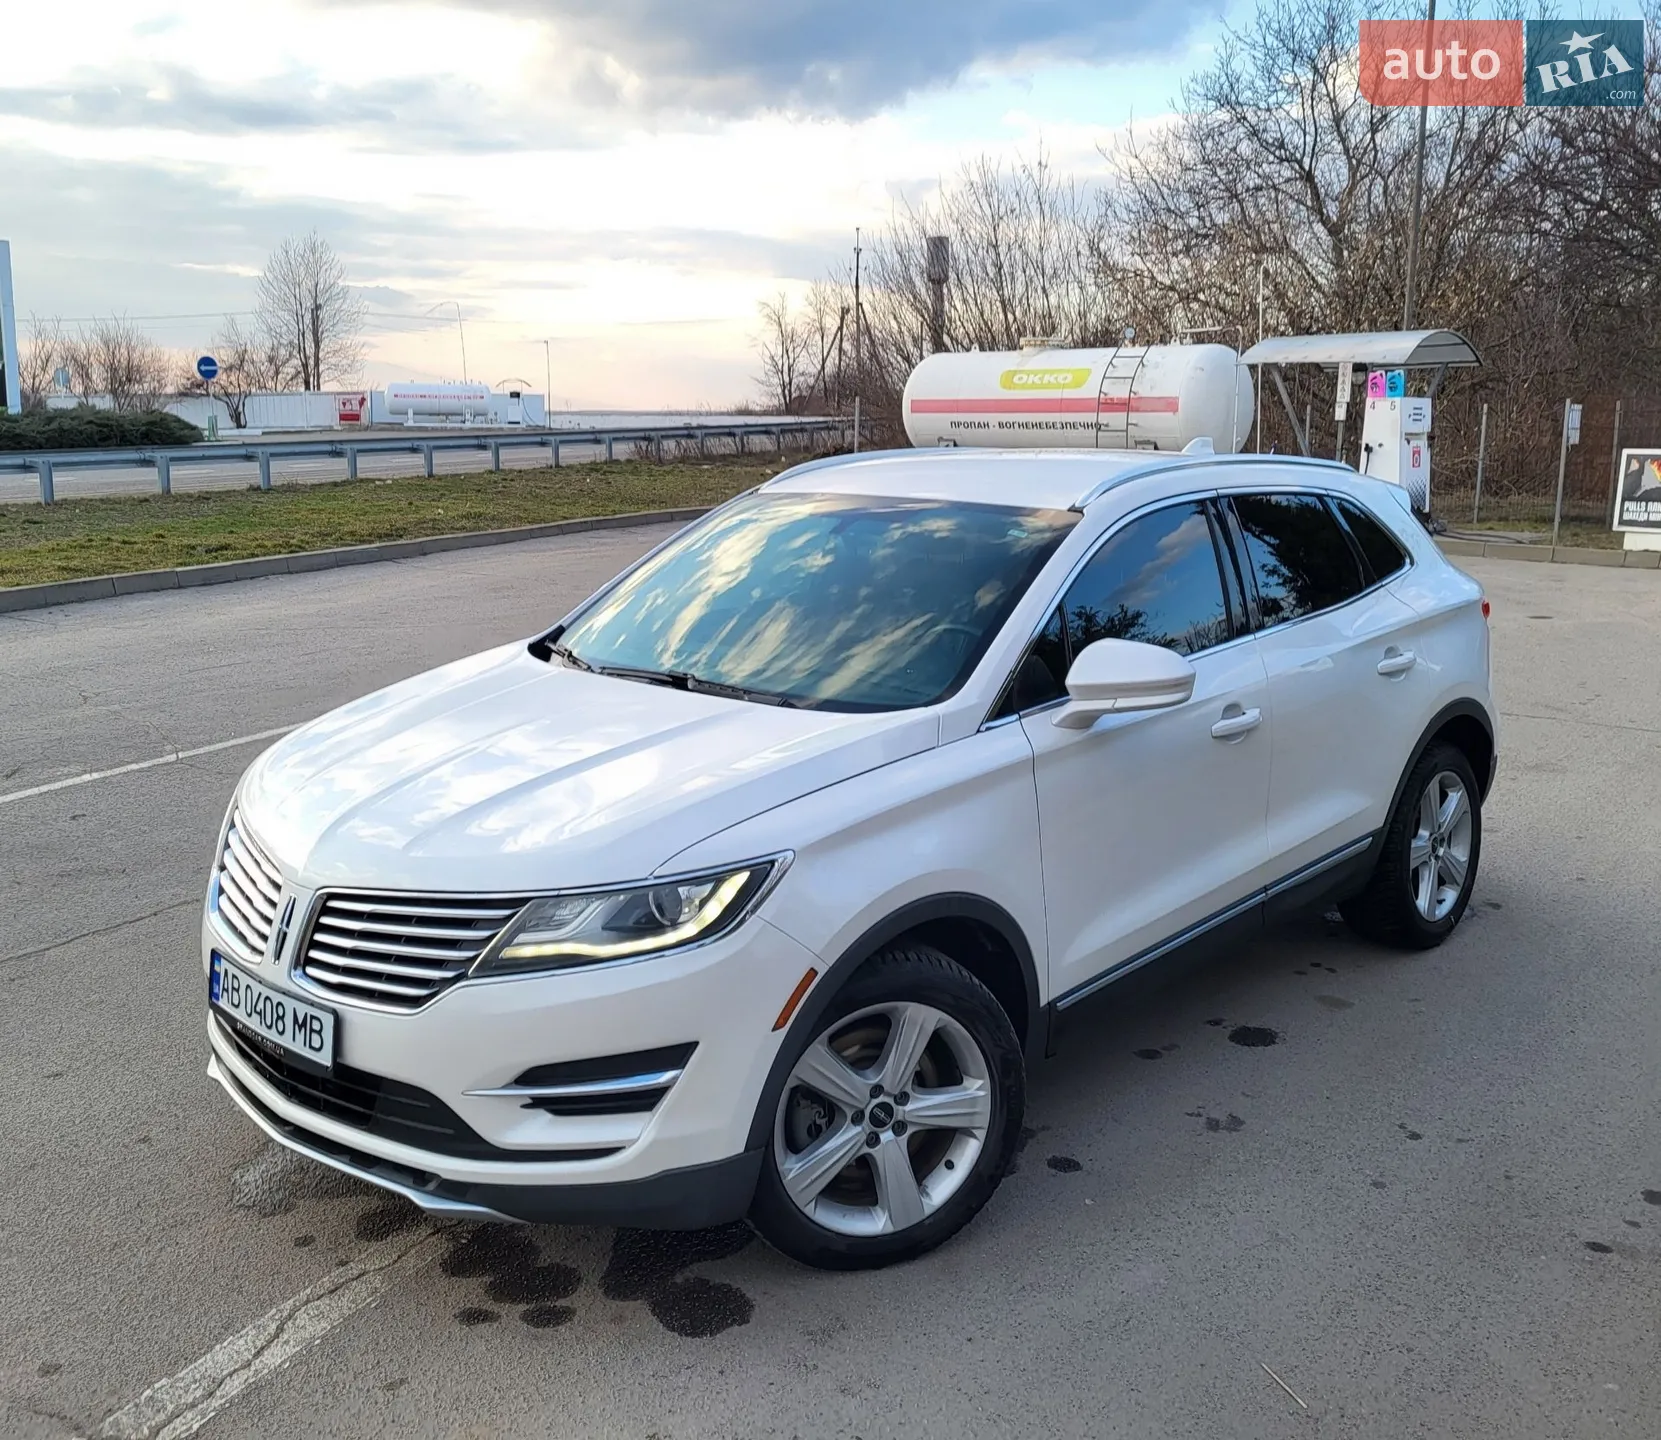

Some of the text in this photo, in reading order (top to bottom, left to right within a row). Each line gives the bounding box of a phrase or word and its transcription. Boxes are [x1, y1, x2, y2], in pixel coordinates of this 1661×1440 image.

[950, 420, 990, 430] ПРОПАН
[1624, 500, 1646, 512] PULLS
[221, 968, 324, 1053] AB 0408 MB
